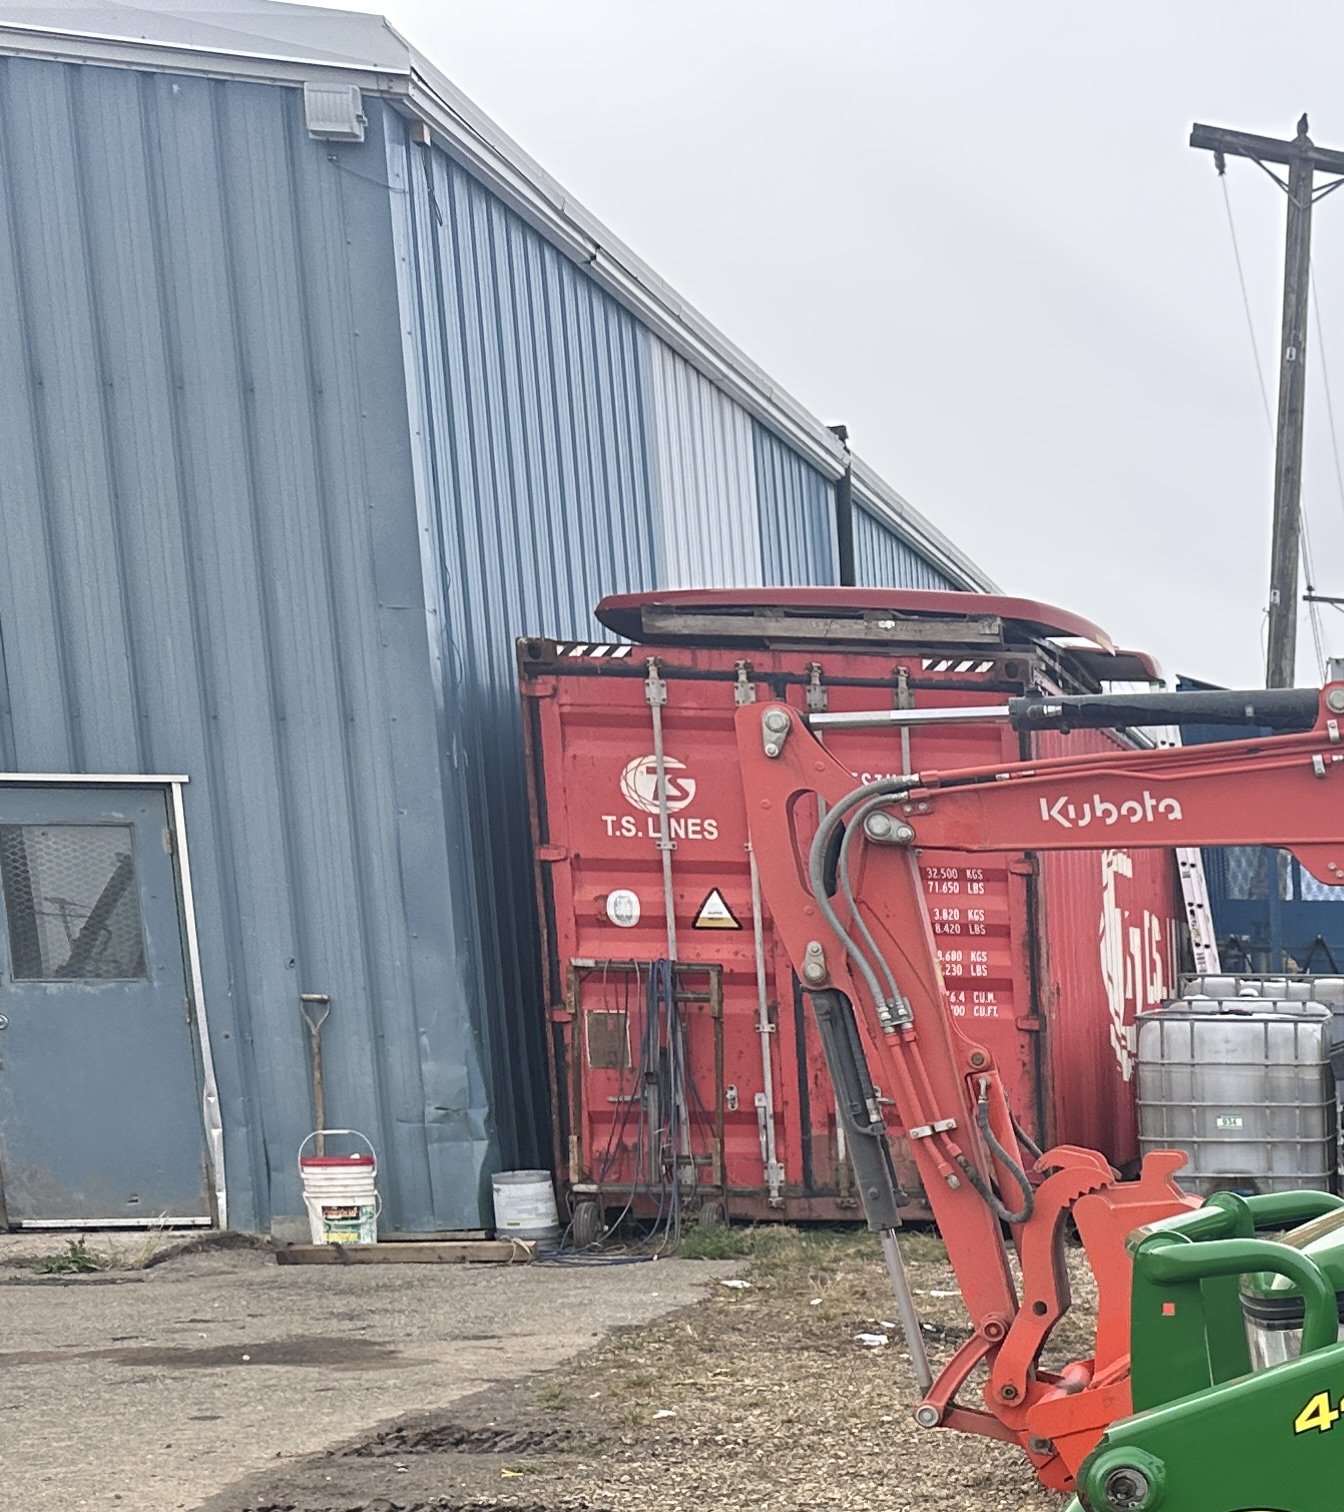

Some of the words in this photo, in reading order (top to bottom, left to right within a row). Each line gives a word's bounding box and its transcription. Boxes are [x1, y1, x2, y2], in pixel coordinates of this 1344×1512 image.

[1039, 790, 1183, 828] Kubota
[602, 815, 643, 838] T.S.
[647, 817, 719, 840] LNES
[926, 867, 958, 880] 32.500
[966, 869, 983, 880] KGS
[927, 881, 959, 894] 71.650
[967, 883, 985, 894] LBS
[934, 908, 959, 921] 3.820
[967, 910, 985, 921] KGS
[934, 923, 961, 935] 8.420
[969, 924, 986, 935] LBS
[970, 951, 988, 963] KGS
[970, 964, 988, 976] LBS
